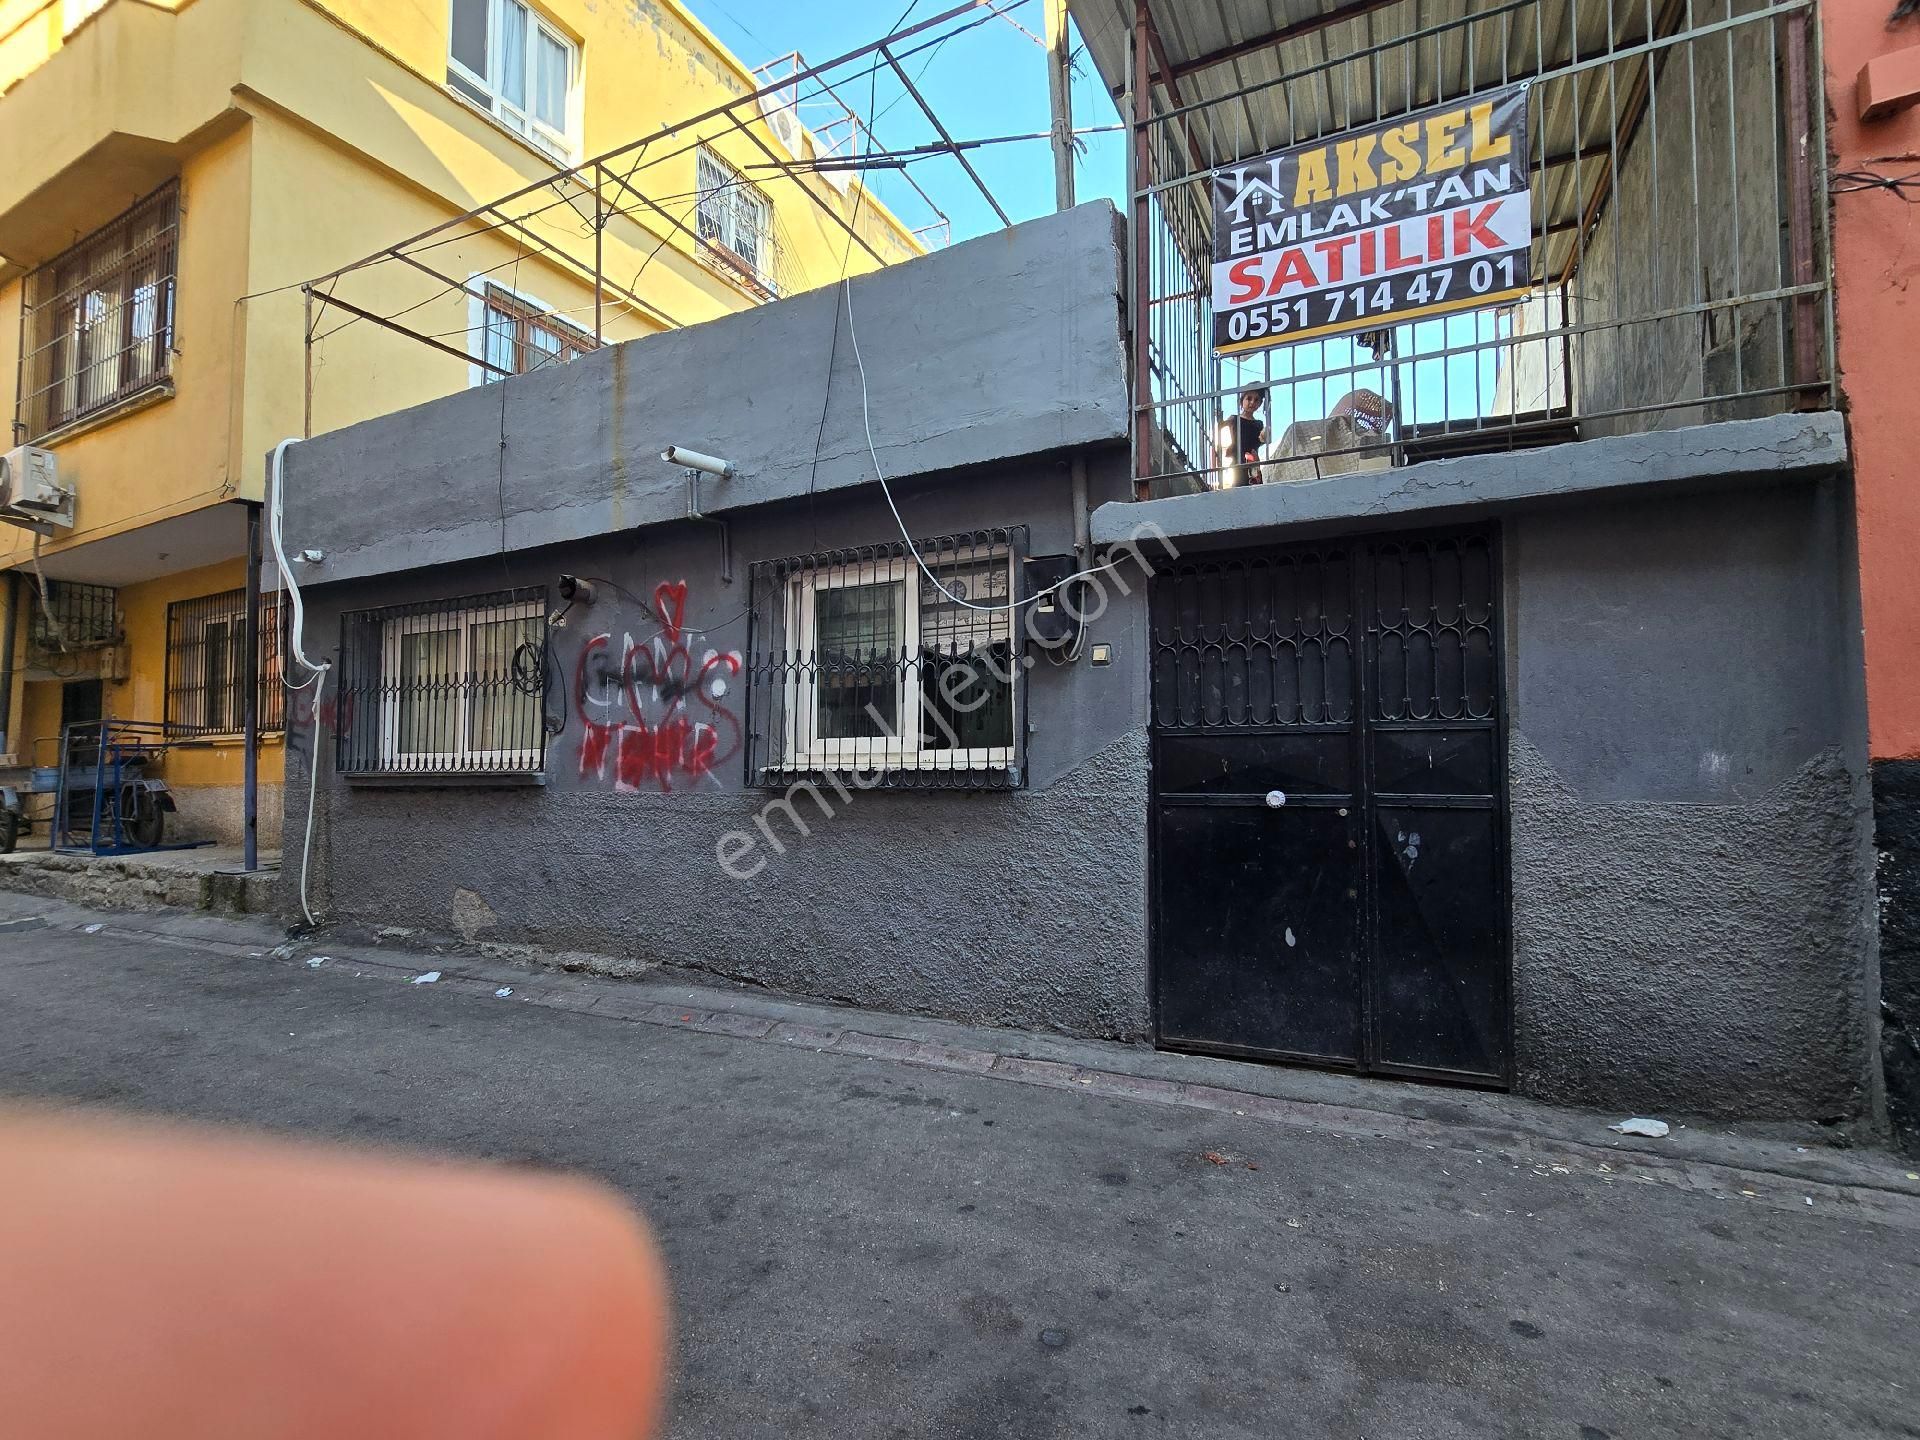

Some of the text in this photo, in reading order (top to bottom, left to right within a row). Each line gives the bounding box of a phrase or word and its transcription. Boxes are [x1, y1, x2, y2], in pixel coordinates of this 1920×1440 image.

[1293, 101, 1511, 208] AKSEL
[1228, 199, 1509, 305] SATILIK
[1230, 162, 1511, 255] EMLAK'TAN
[1228, 255, 1514, 341] 0551 714 47 01
